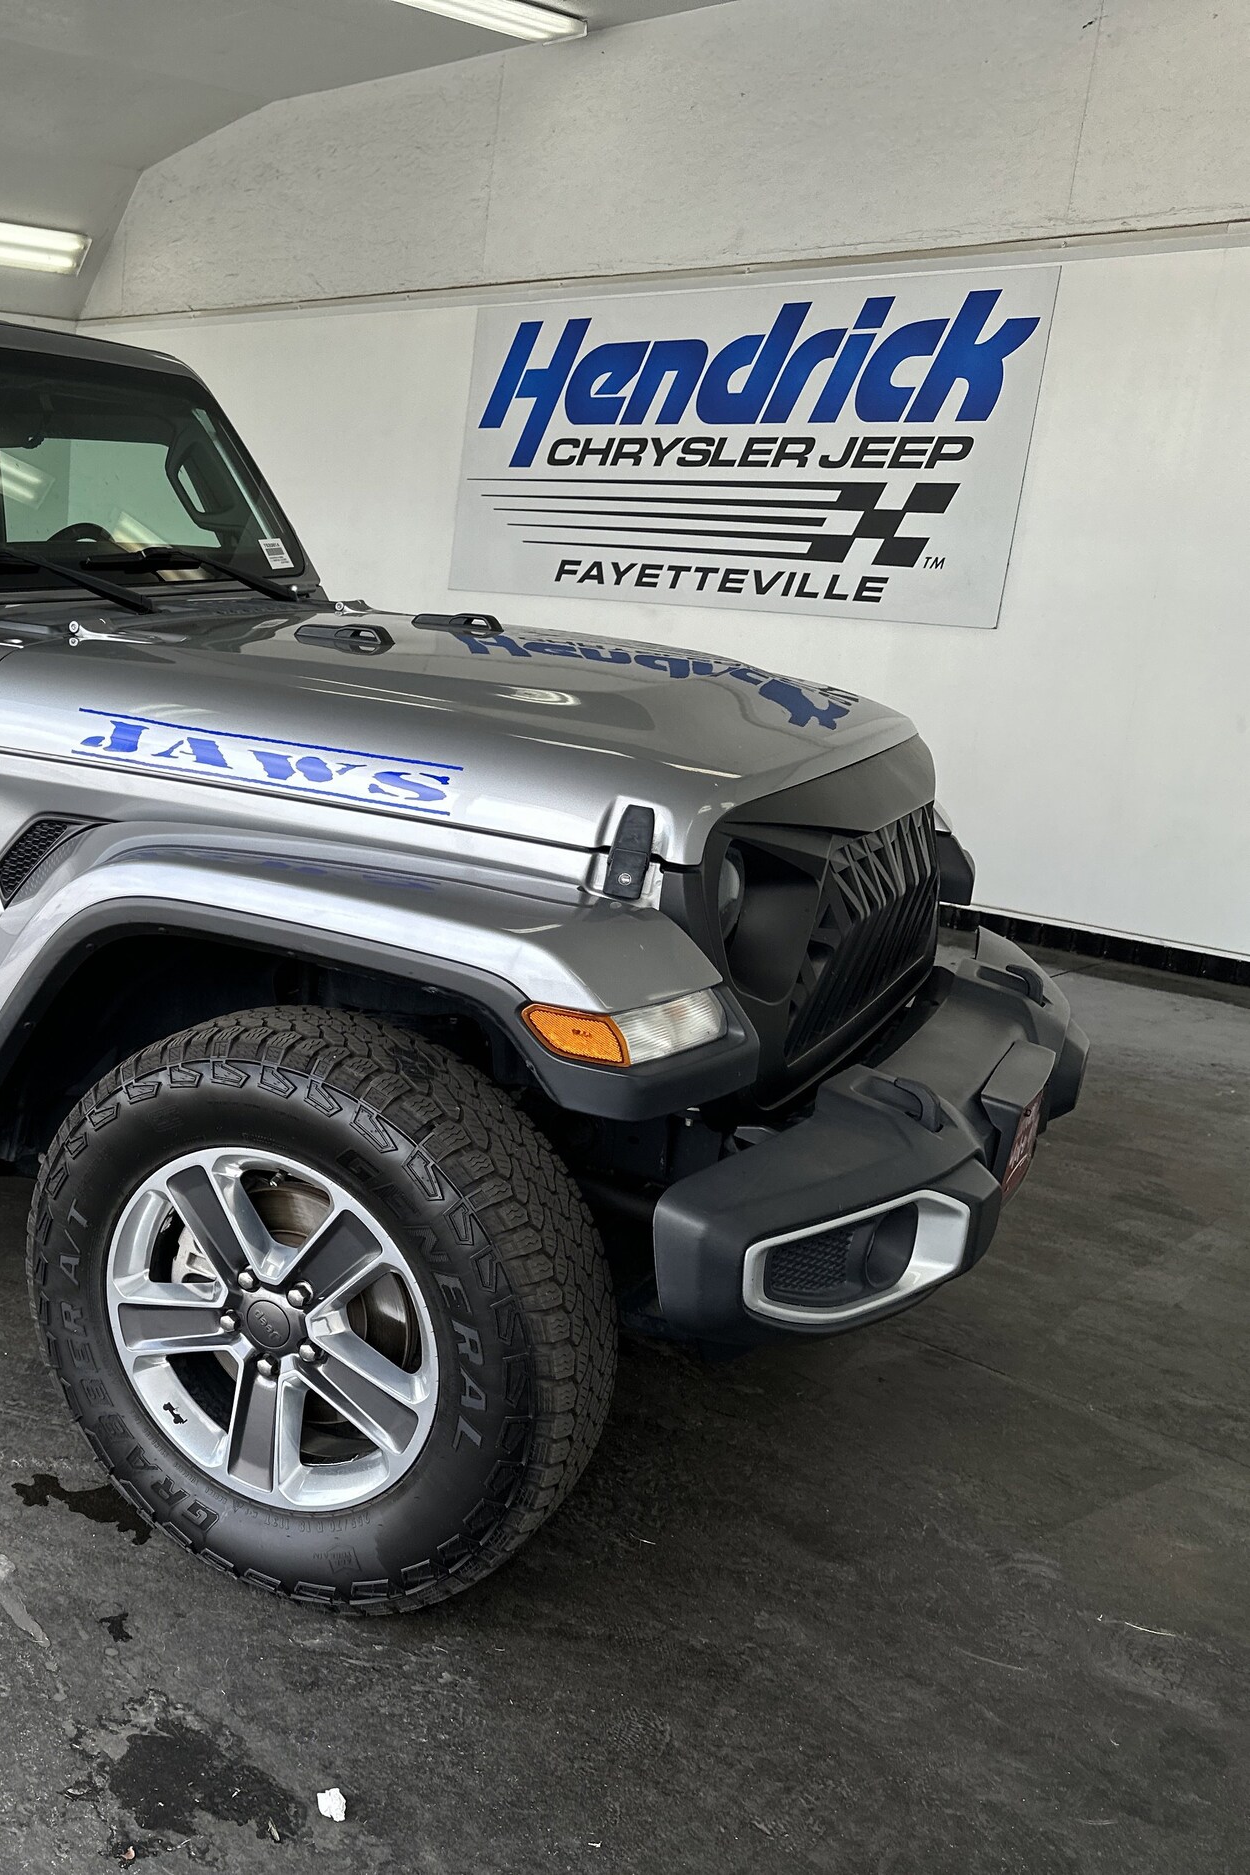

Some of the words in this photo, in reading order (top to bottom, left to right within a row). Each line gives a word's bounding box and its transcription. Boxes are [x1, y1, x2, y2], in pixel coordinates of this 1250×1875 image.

[478, 289, 1041, 468] Hendrick
[547, 436, 814, 469] CHRYSLER
[818, 435, 974, 470] JEEP
[554, 559, 890, 604] FAYETTEVILLE
[923, 556, 946, 571] TM
[80, 720, 450, 801] JAWS
[57, 1198, 91, 1287] A/T
[334, 1149, 488, 1451] GENERAL
[61, 1302, 220, 1541] GRABBER
